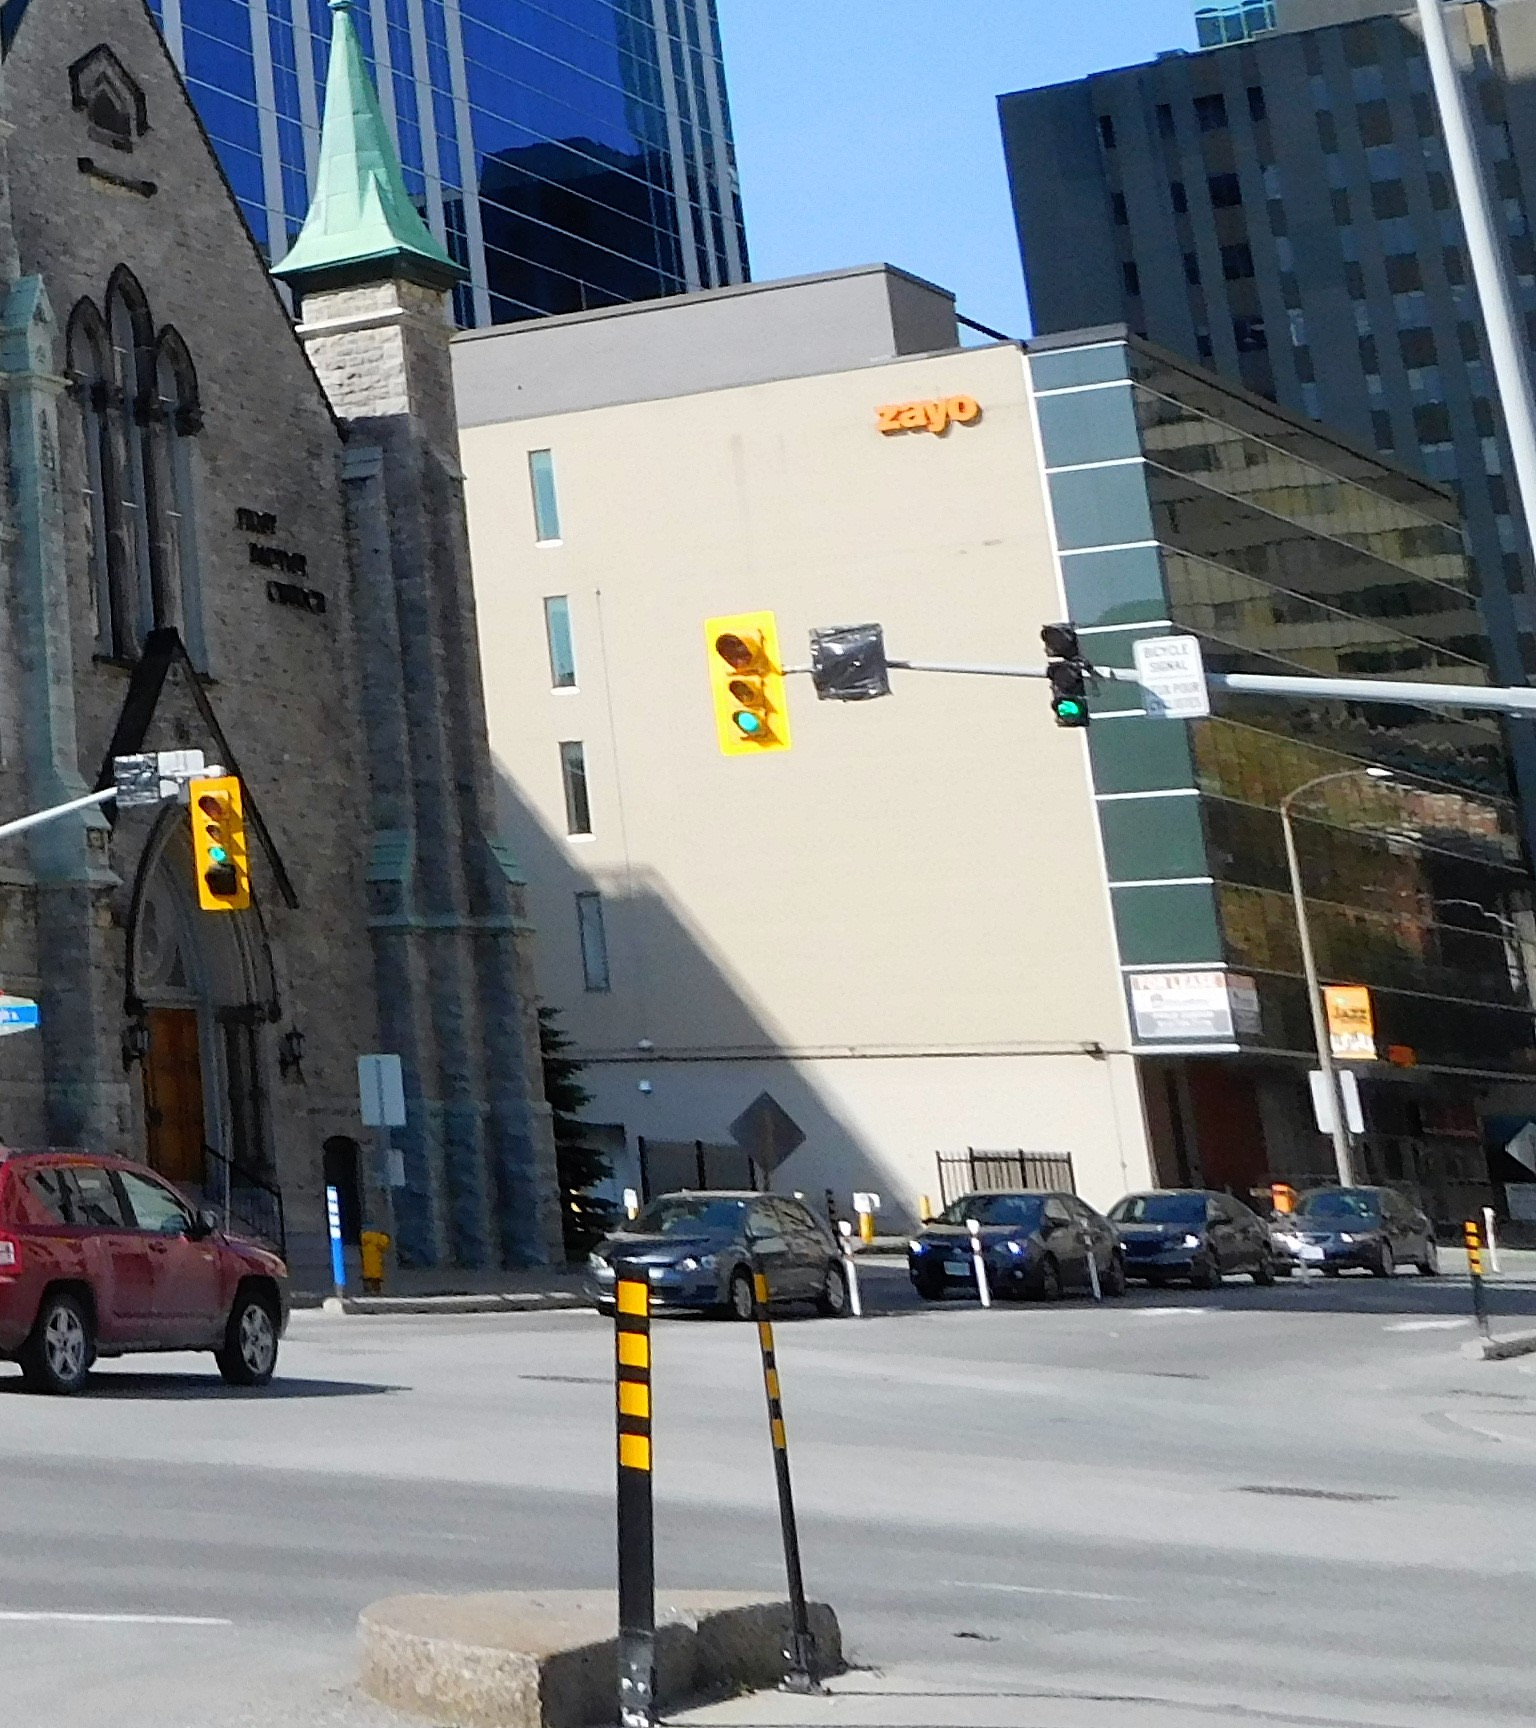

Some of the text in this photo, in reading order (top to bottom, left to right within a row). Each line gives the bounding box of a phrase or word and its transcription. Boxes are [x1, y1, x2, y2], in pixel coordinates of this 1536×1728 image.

[873, 396, 979, 435] zayo
[1143, 643, 1190, 659] BICYCLE
[1150, 660, 1189, 673] SIGNAL
[1139, 973, 1218, 990] FOR LEASE
